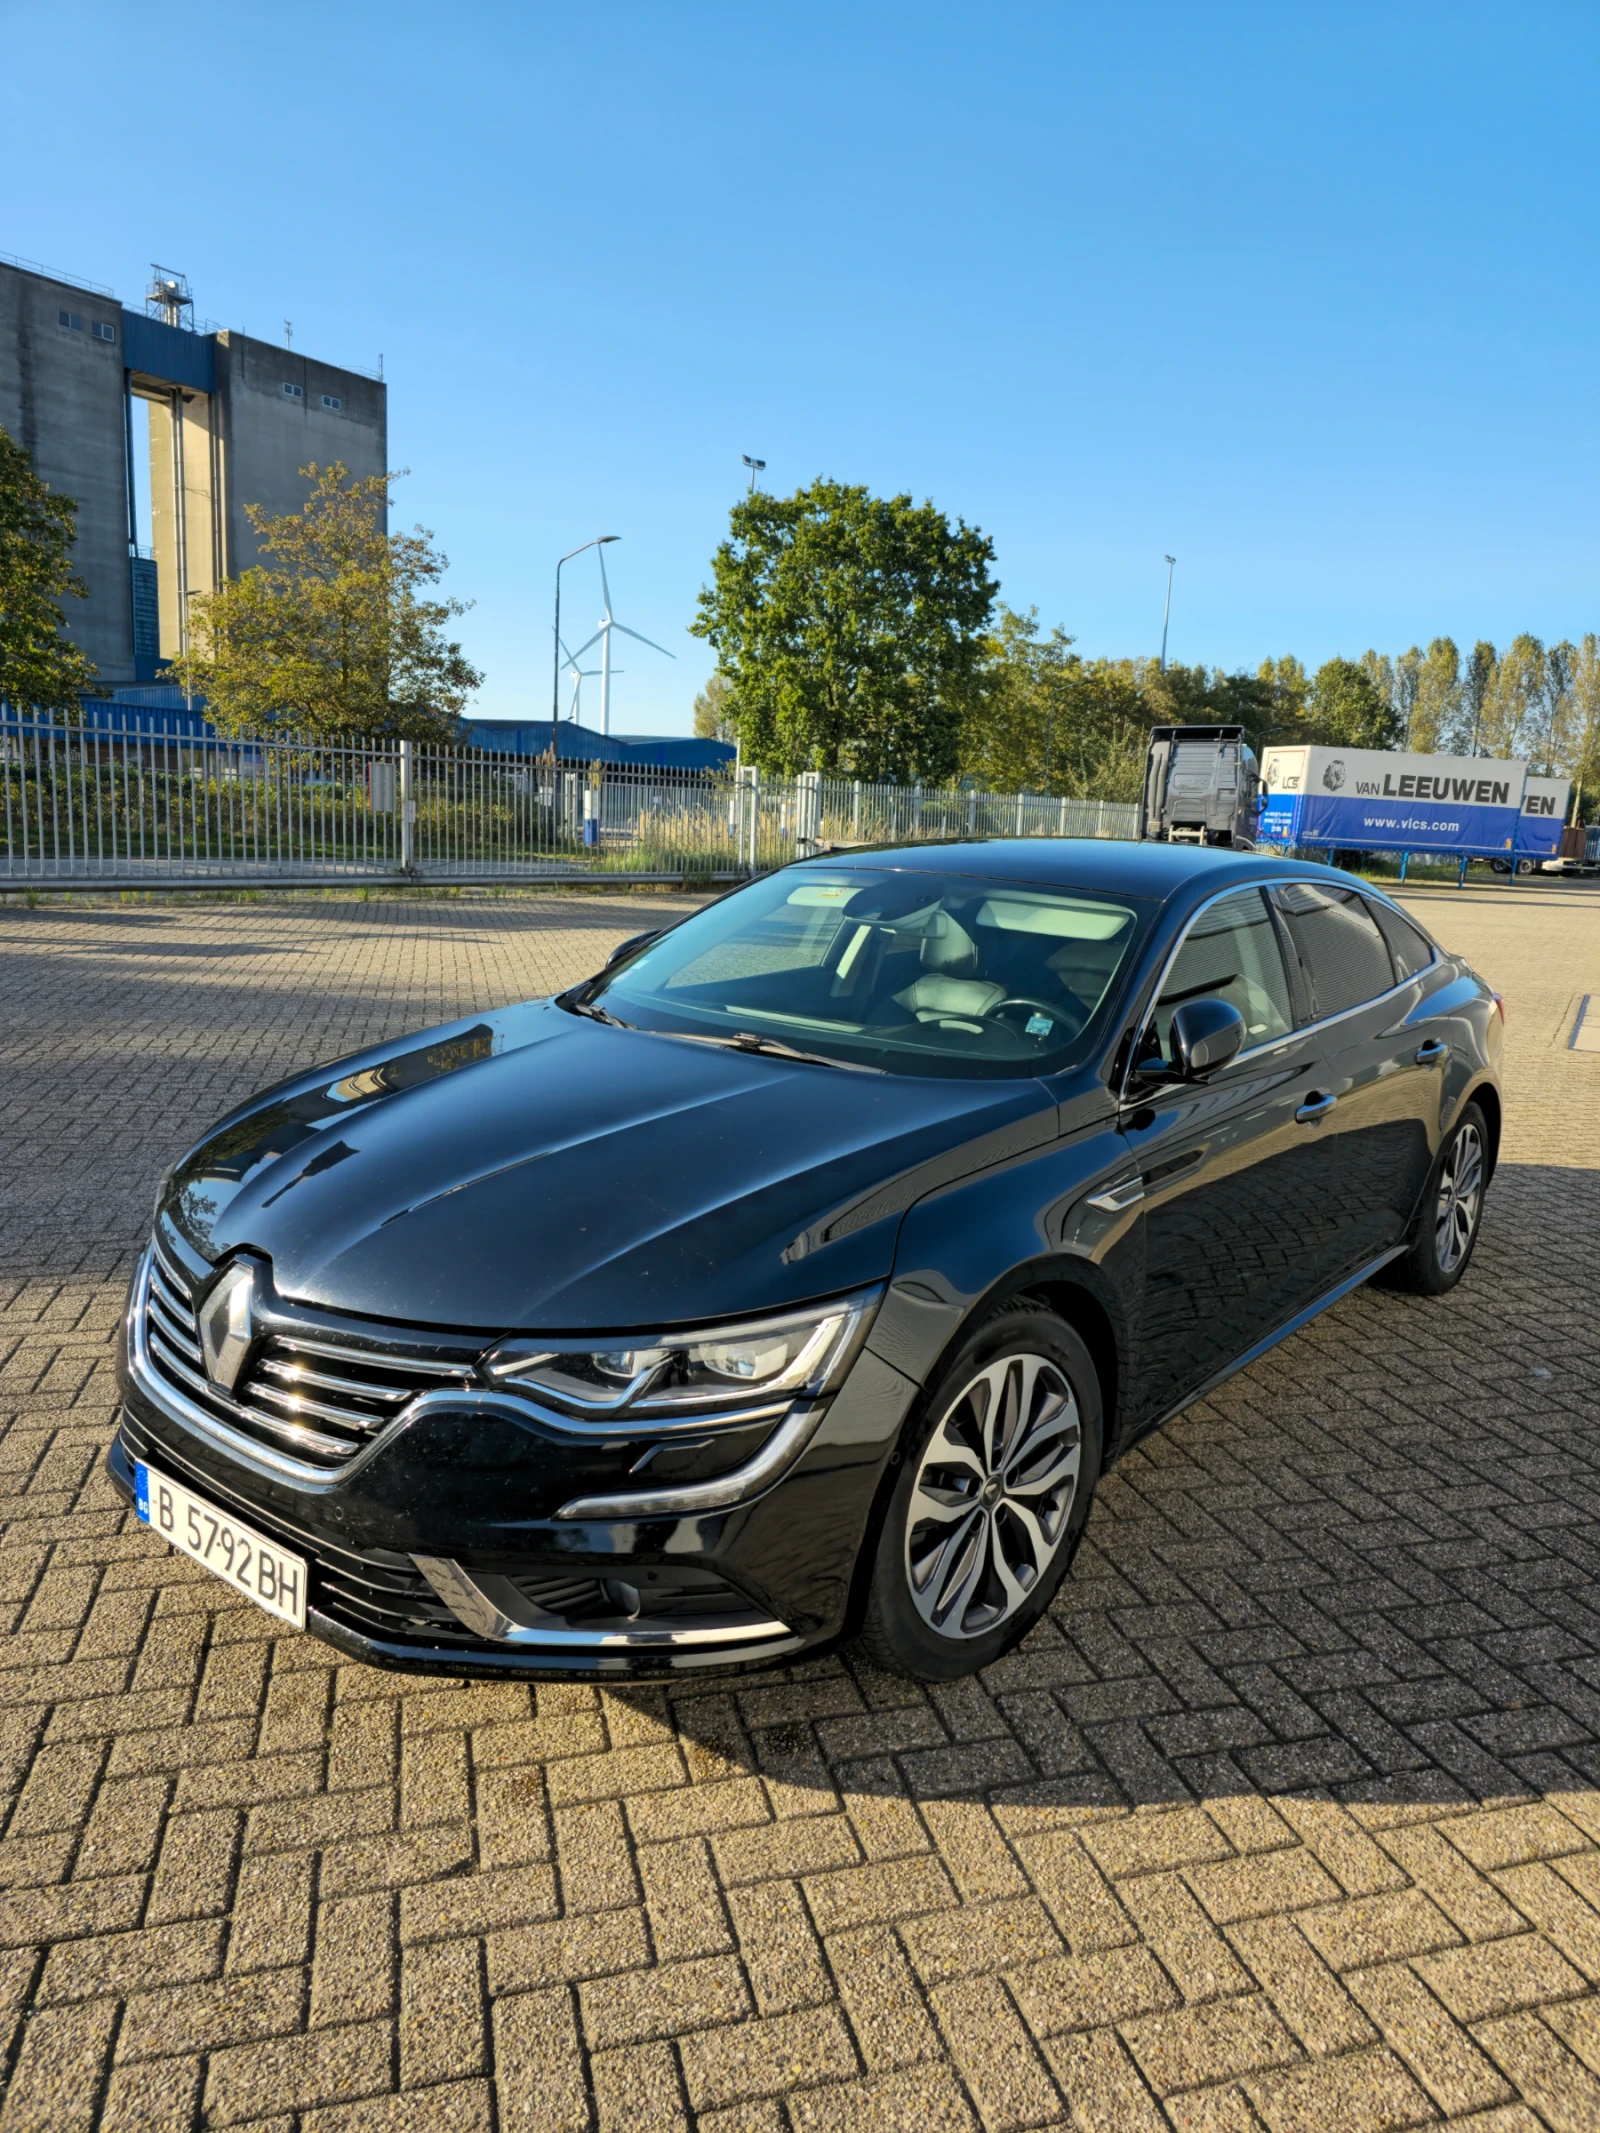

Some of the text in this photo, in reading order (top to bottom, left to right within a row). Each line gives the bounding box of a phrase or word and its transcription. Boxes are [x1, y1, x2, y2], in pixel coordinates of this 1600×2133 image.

[1356, 774, 1510, 804] VAN LEEUWEN
[1364, 817, 1460, 832] www.vlcs.com
[138, 1497, 149, 1514] BG
